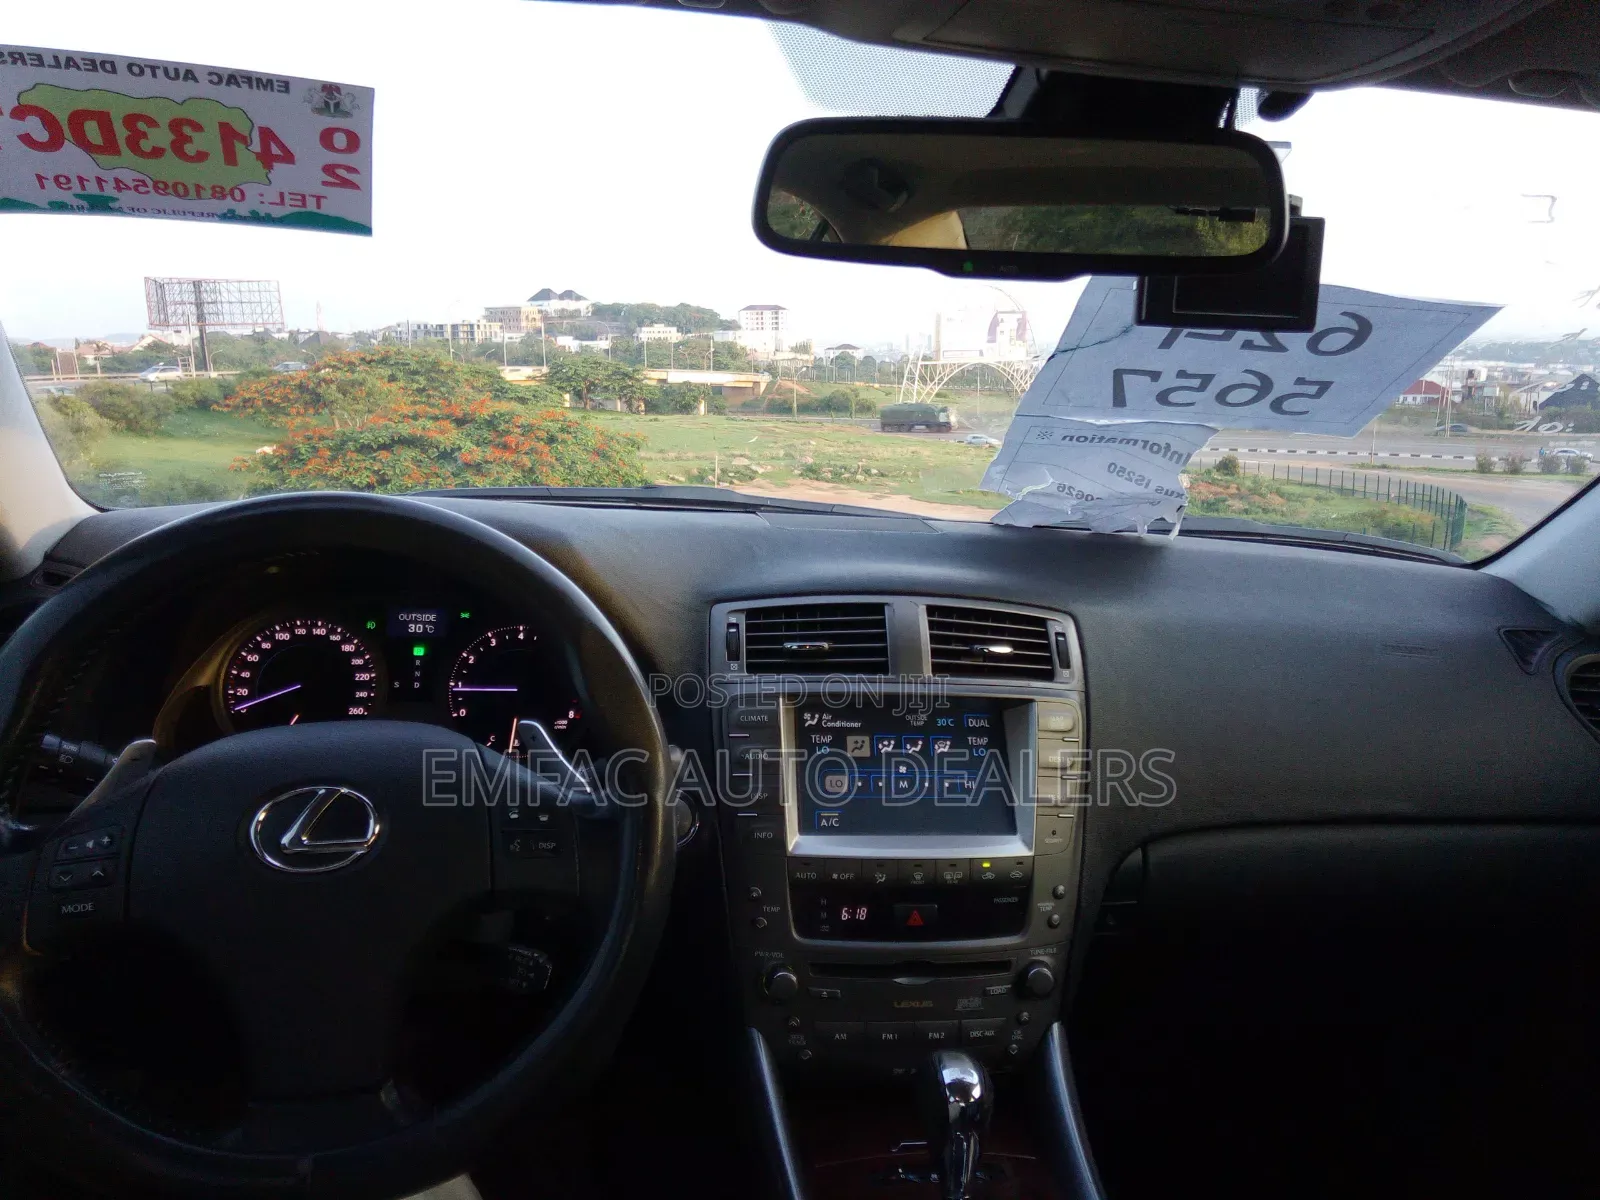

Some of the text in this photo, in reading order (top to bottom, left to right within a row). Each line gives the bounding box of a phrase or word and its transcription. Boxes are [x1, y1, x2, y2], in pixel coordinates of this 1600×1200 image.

[398, 613, 437, 622] OUTSIDE
[294, 628, 307, 636] 120
[312, 628, 327, 636] 140
[407, 624, 435, 633] 30°C
[274, 632, 291, 641] 100
[261, 642, 272, 650] 80
[489, 638, 496, 647] 3
[340, 644, 355, 652] 180
[246, 654, 259, 662] 60
[468, 656, 475, 664] 2
[354, 673, 370, 681] 220
[236, 688, 249, 696] 20
[348, 707, 364, 715] 260
[459, 709, 466, 717] 0
[568, 710, 575, 719] 8
[821, 720, 862, 729] Conditioner
[968, 719, 990, 728] DUAL
[810, 735, 833, 744] TEMP
[967, 737, 989, 746] TEMP
[815, 746, 830, 755] LO
[973, 748, 986, 757] LO
[829, 779, 843, 788] LO
[899, 781, 908, 789] M
[820, 818, 840, 828] A/C
[795, 872, 817, 880] AUTO
[61, 902, 95, 914] MODE
[840, 907, 868, 921] 6:18
[833, 1033, 848, 1041] AM
